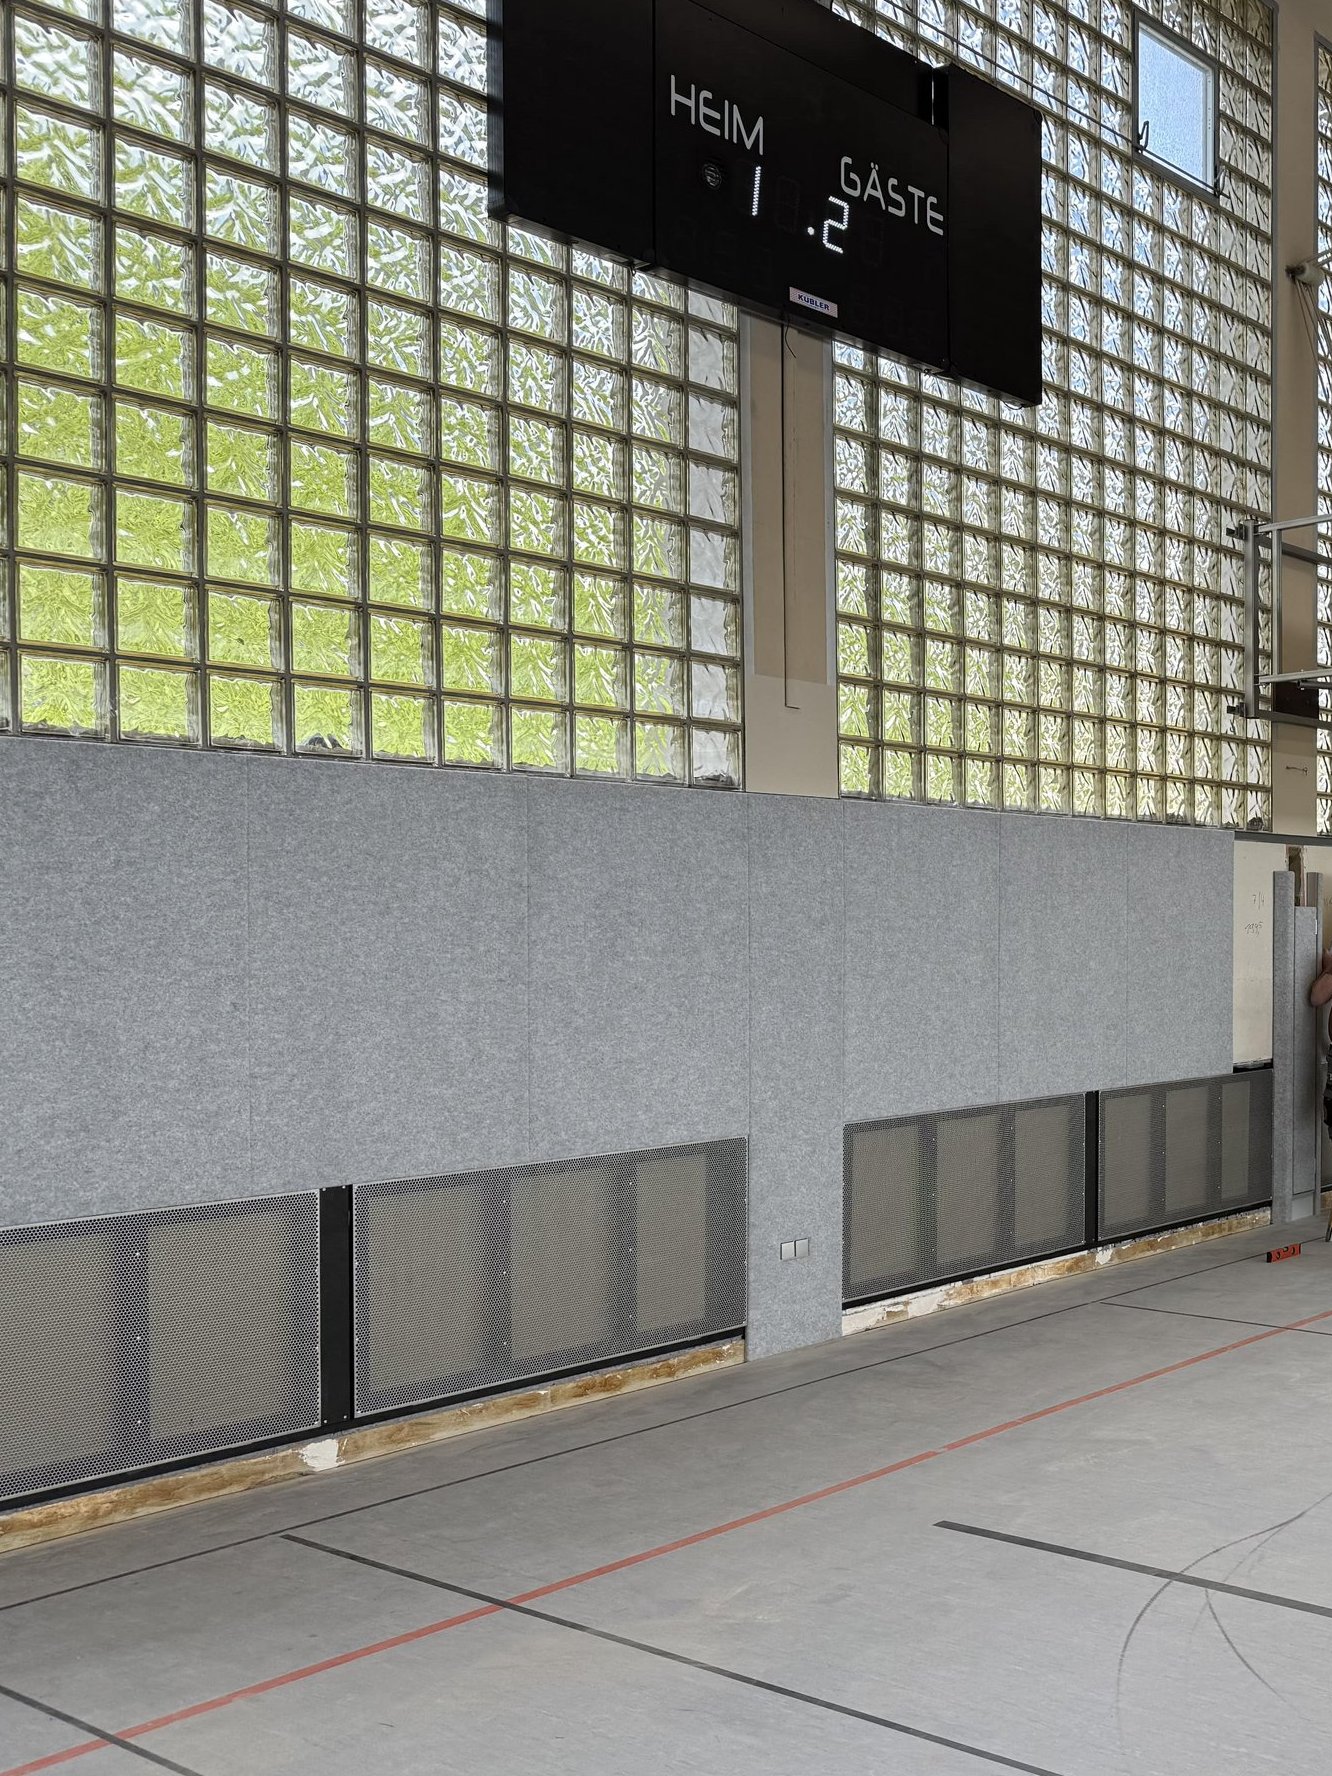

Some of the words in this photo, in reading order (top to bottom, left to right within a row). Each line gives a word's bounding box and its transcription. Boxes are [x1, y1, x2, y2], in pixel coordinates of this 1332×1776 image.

[670, 74, 764, 156] HEIM
[752, 165, 762, 217] 1
[840, 155, 944, 236] GÄSTE
